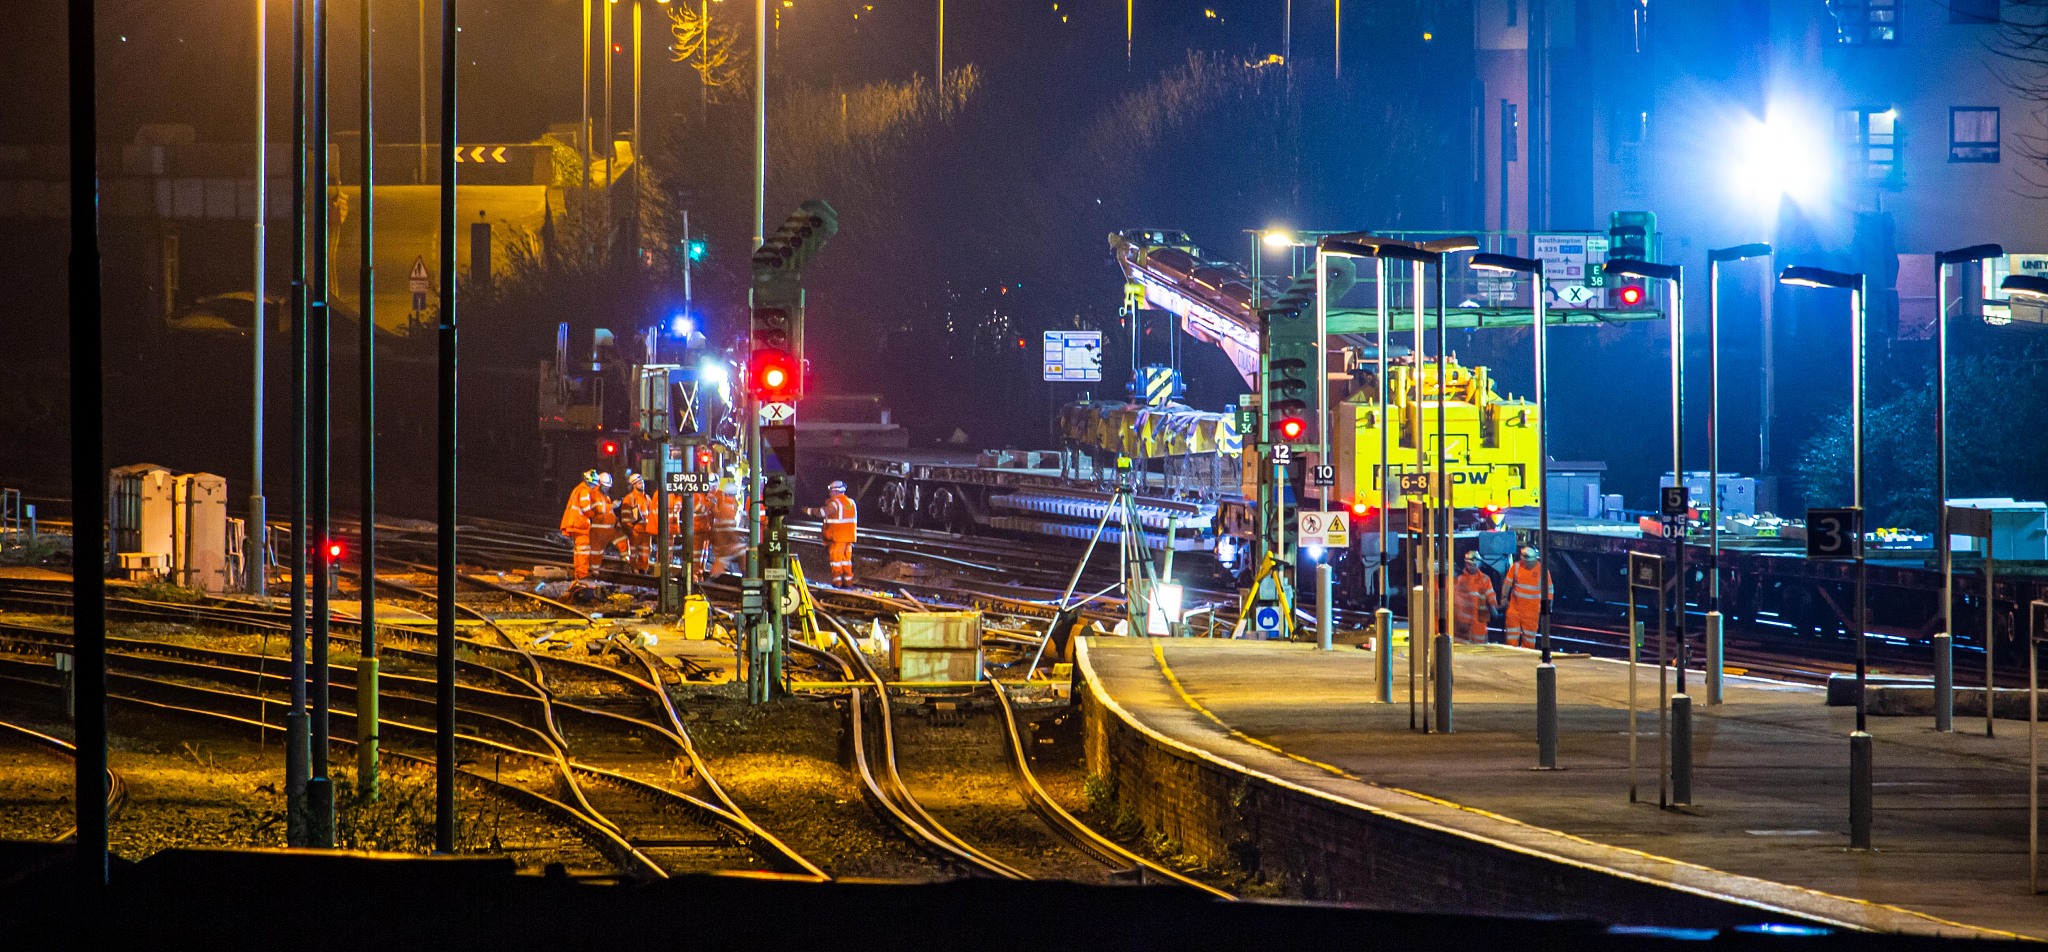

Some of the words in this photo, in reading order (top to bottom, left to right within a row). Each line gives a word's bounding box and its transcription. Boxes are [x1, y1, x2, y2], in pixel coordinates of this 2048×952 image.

[1593, 265, 1600, 275] E
[1591, 276, 1603, 287] 38
[1570, 288, 1581, 302] X
[771, 404, 782, 419] X
[1243, 411, 1250, 422] E
[1241, 423, 1253, 434] 36
[1273, 444, 1290, 459] 12
[1316, 465, 1333, 479] 10
[673, 473, 698, 483] SPAD
[1401, 476, 1428, 489] 6-8
[666, 482, 699, 492] E34/36
[702, 482, 710, 492] D
[1668, 489, 1681, 507] 5
[772, 531, 779, 541] E
[1819, 517, 1842, 552] 3
[768, 542, 781, 552] 34
